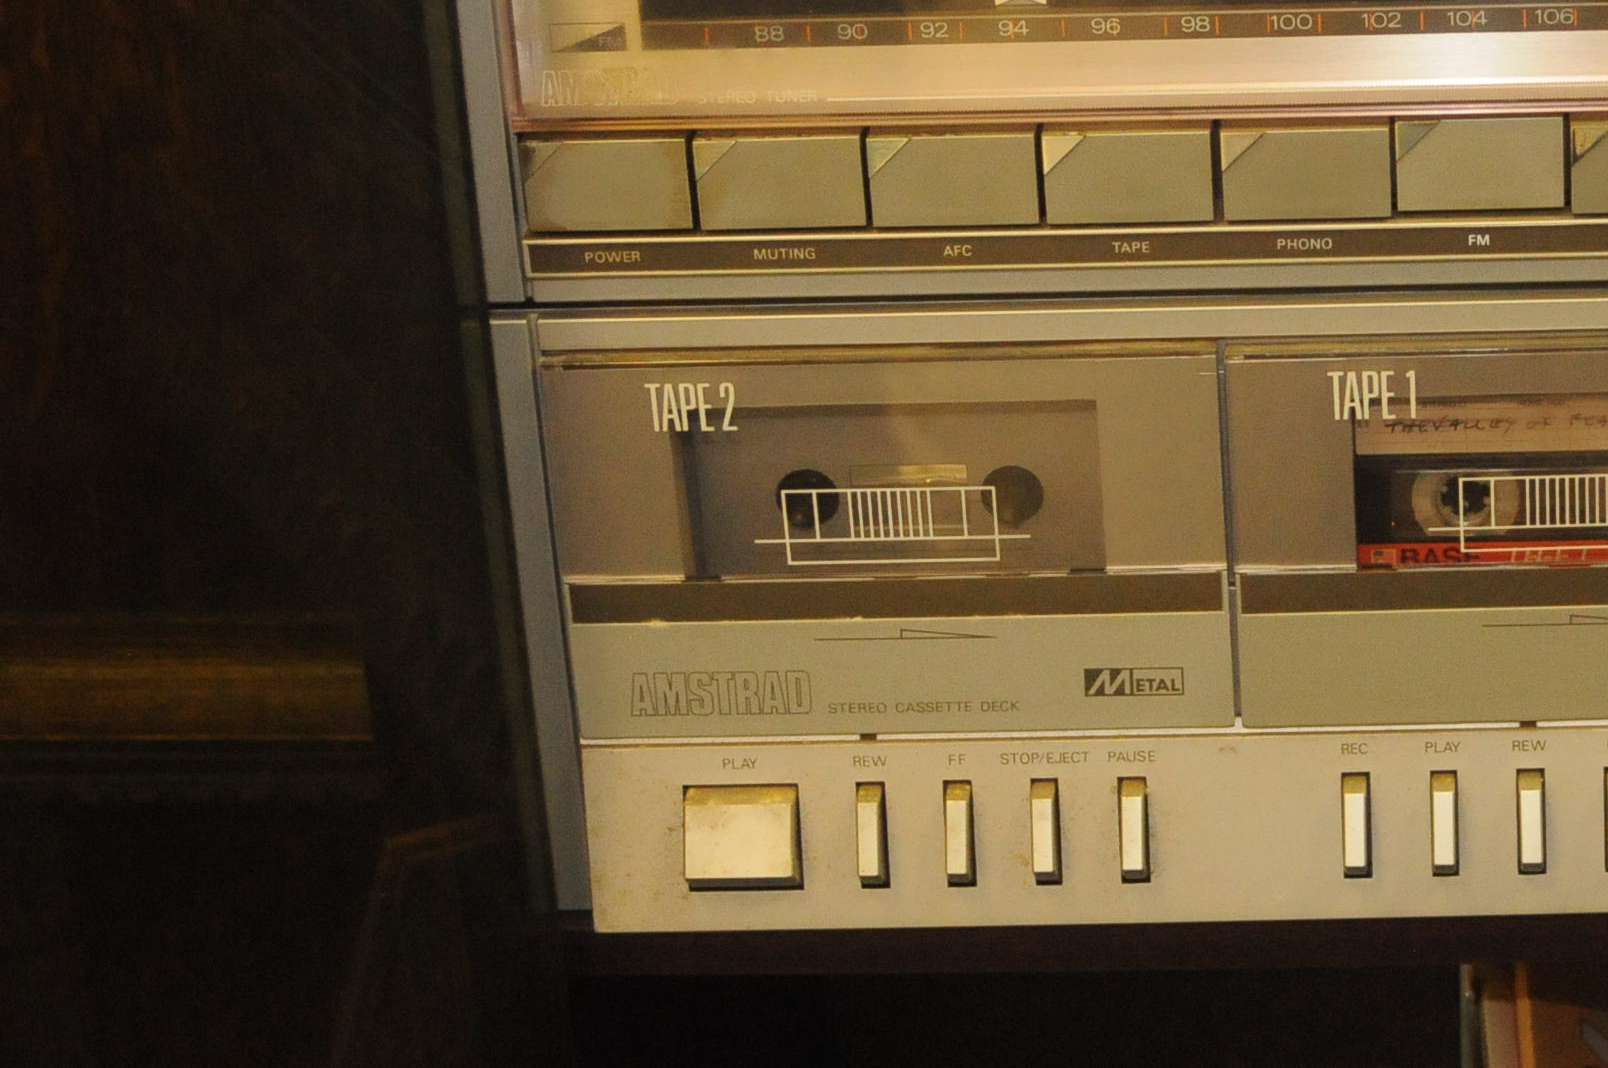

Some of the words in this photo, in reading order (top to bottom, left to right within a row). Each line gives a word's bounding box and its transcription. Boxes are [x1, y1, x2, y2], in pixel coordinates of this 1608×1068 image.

[754, 25, 784, 42] 88
[837, 24, 868, 39] 90
[920, 22, 949, 38] 92
[998, 20, 1029, 36] 94
[1090, 18, 1121, 34] 96
[1181, 16, 1210, 32] 98
[1270, 13, 1312, 30] 100
[1361, 12, 1402, 28] 102
[1447, 10, 1488, 26] 104
[1534, 8, 1574, 24] 106
[767, 89, 818, 103] TUNER
[1276, 236, 1333, 251] PHONO
[1468, 233, 1491, 247] FM
[753, 247, 816, 262] MUTING
[943, 244, 973, 258] AFC
[1112, 241, 1150, 255] TAPE
[584, 250, 641, 264] POWER
[1327, 370, 1397, 421] TAPE
[1405, 369, 1418, 420] 1
[645, 382, 715, 433] TAPE
[719, 381, 739, 432] 2
[1086, 668, 1183, 696] METAL
[630, 670, 813, 717] AMSTRAD
[828, 702, 888, 715] STEREO
[895, 701, 974, 714] CASSETTE
[980, 700, 1020, 713] DECK
[1340, 743, 1369, 756] REC
[1424, 741, 1462, 755] PLAY
[1511, 739, 1548, 753] REW
[852, 755, 888, 769] REW
[948, 753, 967, 766] FF
[999, 750, 1090, 766] STOP/EJECT
[1107, 749, 1156, 764] PAUSE
[722, 757, 758, 771] PLAY
